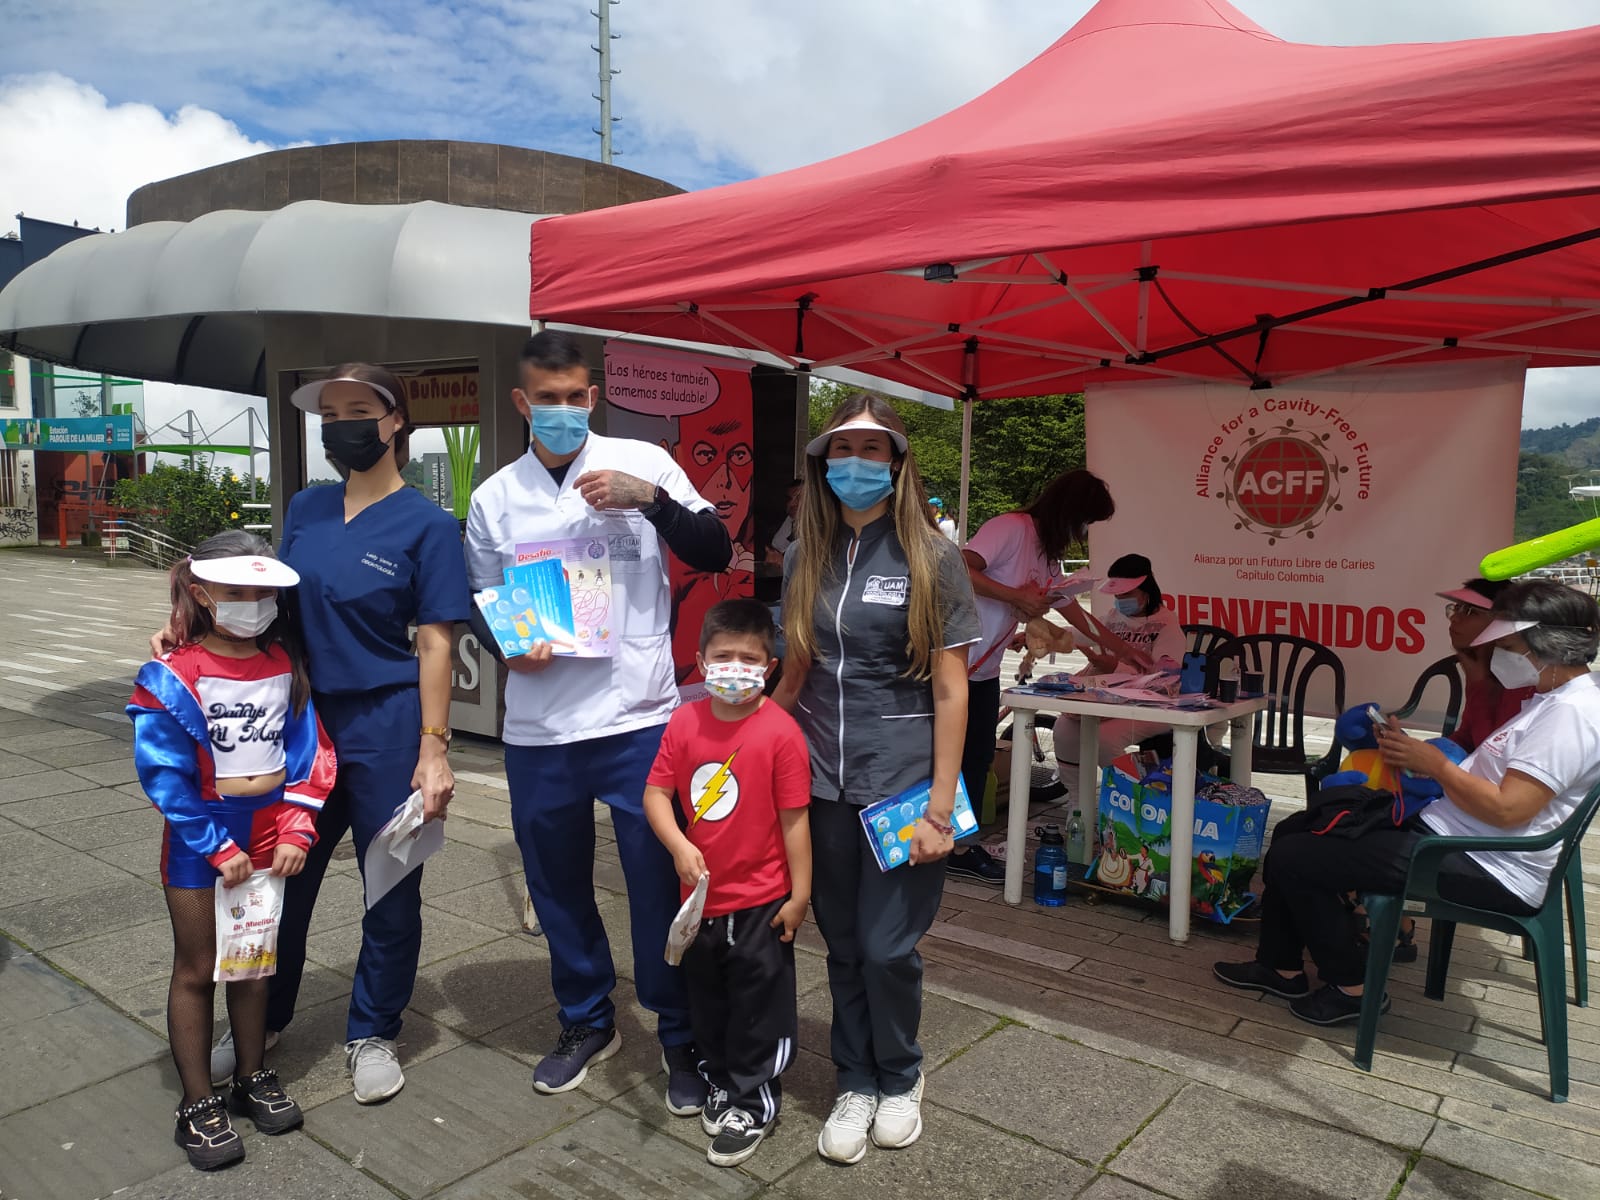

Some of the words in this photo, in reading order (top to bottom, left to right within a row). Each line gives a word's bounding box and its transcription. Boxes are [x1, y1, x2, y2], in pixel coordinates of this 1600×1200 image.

[632, 364, 668, 382] héroes
[671, 370, 709, 386] también
[609, 385, 658, 400] comemos
[660, 388, 708, 403] saludable!
[49, 434, 71, 443] PARQUE
[71, 434, 78, 443] DE
[79, 434, 86, 443] LA
[86, 434, 105, 443] MUJER
[1196, 435, 1224, 498] Alliance
[1221, 412, 1244, 435] for
[1249, 407, 1259, 418] a
[1264, 398, 1357, 441] Cavity-Free
[1353, 442, 1373, 500] Future
[1238, 470, 1325, 495] ACFF
[1194, 553, 1226, 565] Alianza
[1228, 555, 1244, 567] por
[1246, 557, 1259, 567] un
[1261, 556, 1293, 568] Futuro
[1295, 557, 1321, 569] Libre
[1324, 558, 1338, 569] de
[1341, 558, 1375, 570] Caries
[1277, 571, 1325, 583] Colombia
[883, 581, 904, 592] UAM
